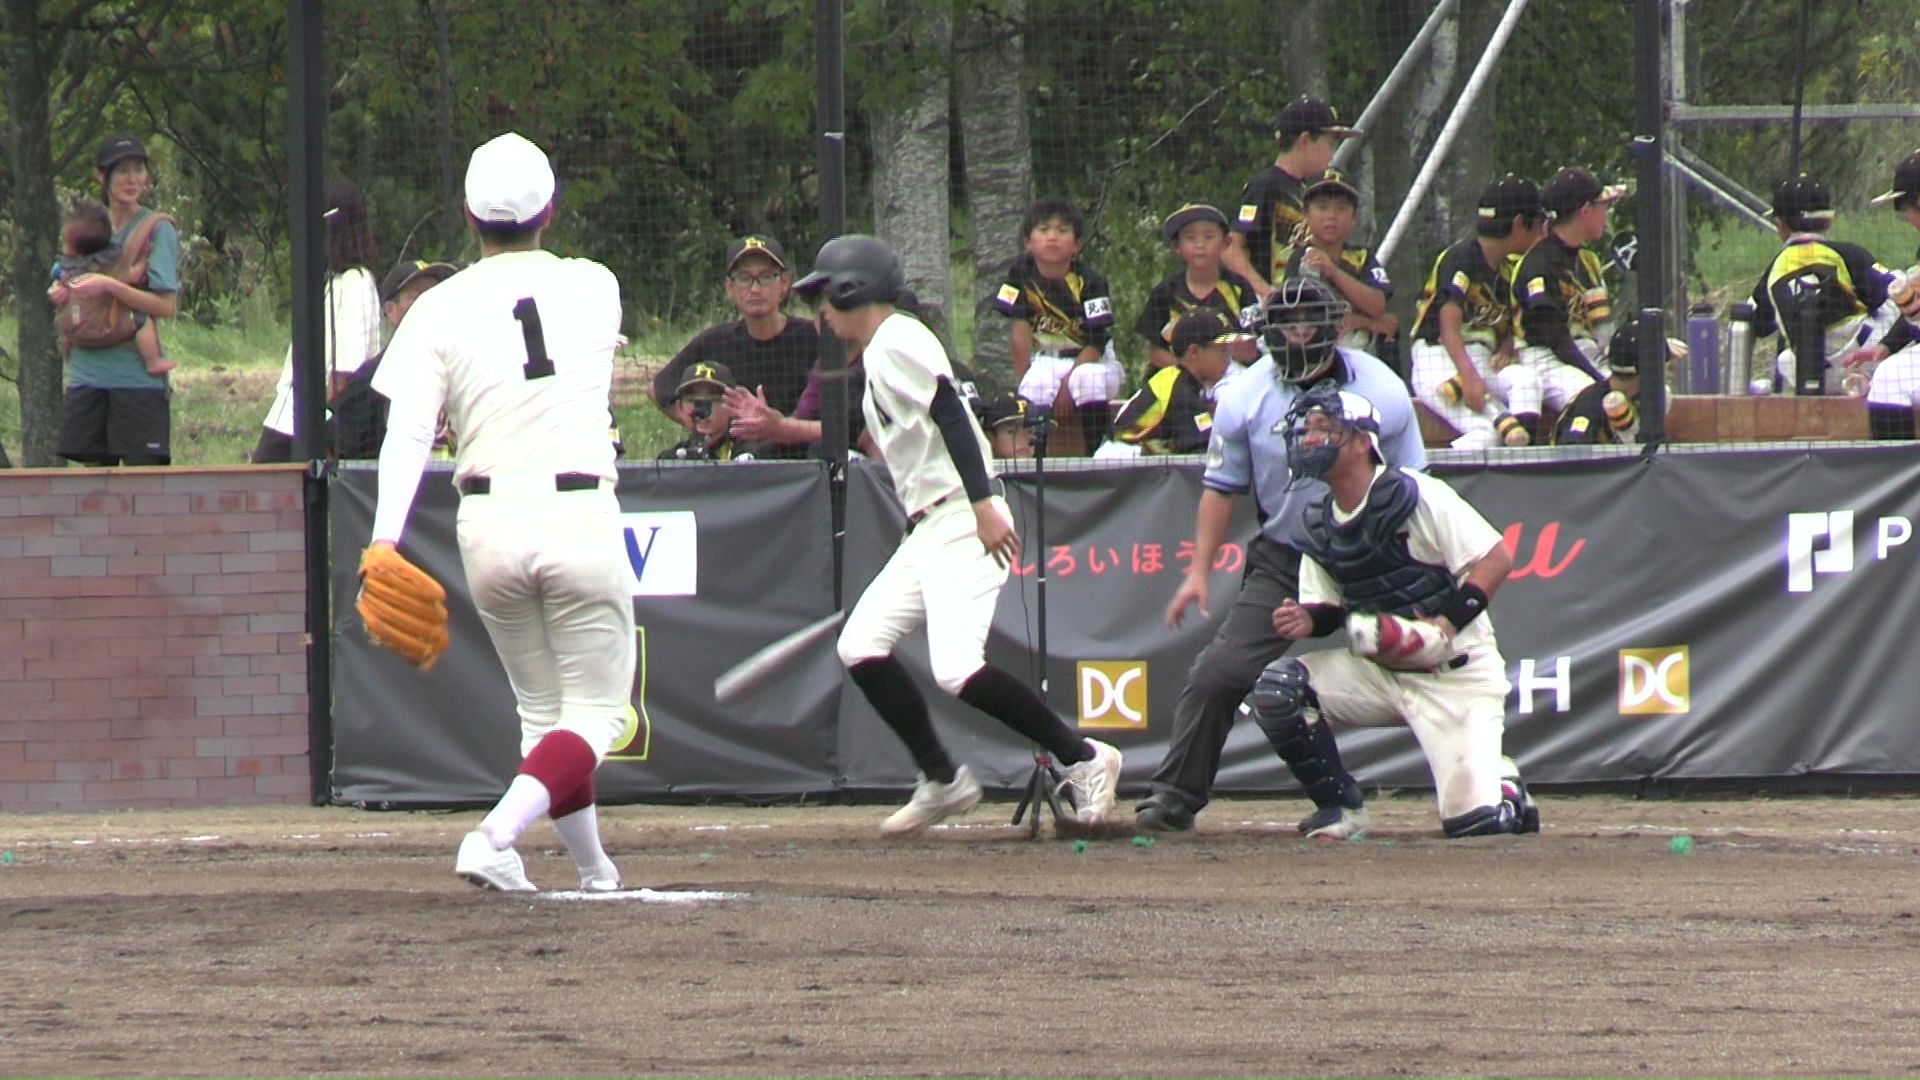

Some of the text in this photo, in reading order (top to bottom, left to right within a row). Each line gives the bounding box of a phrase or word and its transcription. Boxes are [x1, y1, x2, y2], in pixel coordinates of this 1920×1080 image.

[512, 296, 556, 381] 1
[1877, 516, 1913, 560] P
[1081, 667, 1142, 722] DC
[1624, 652, 1684, 707] DC
